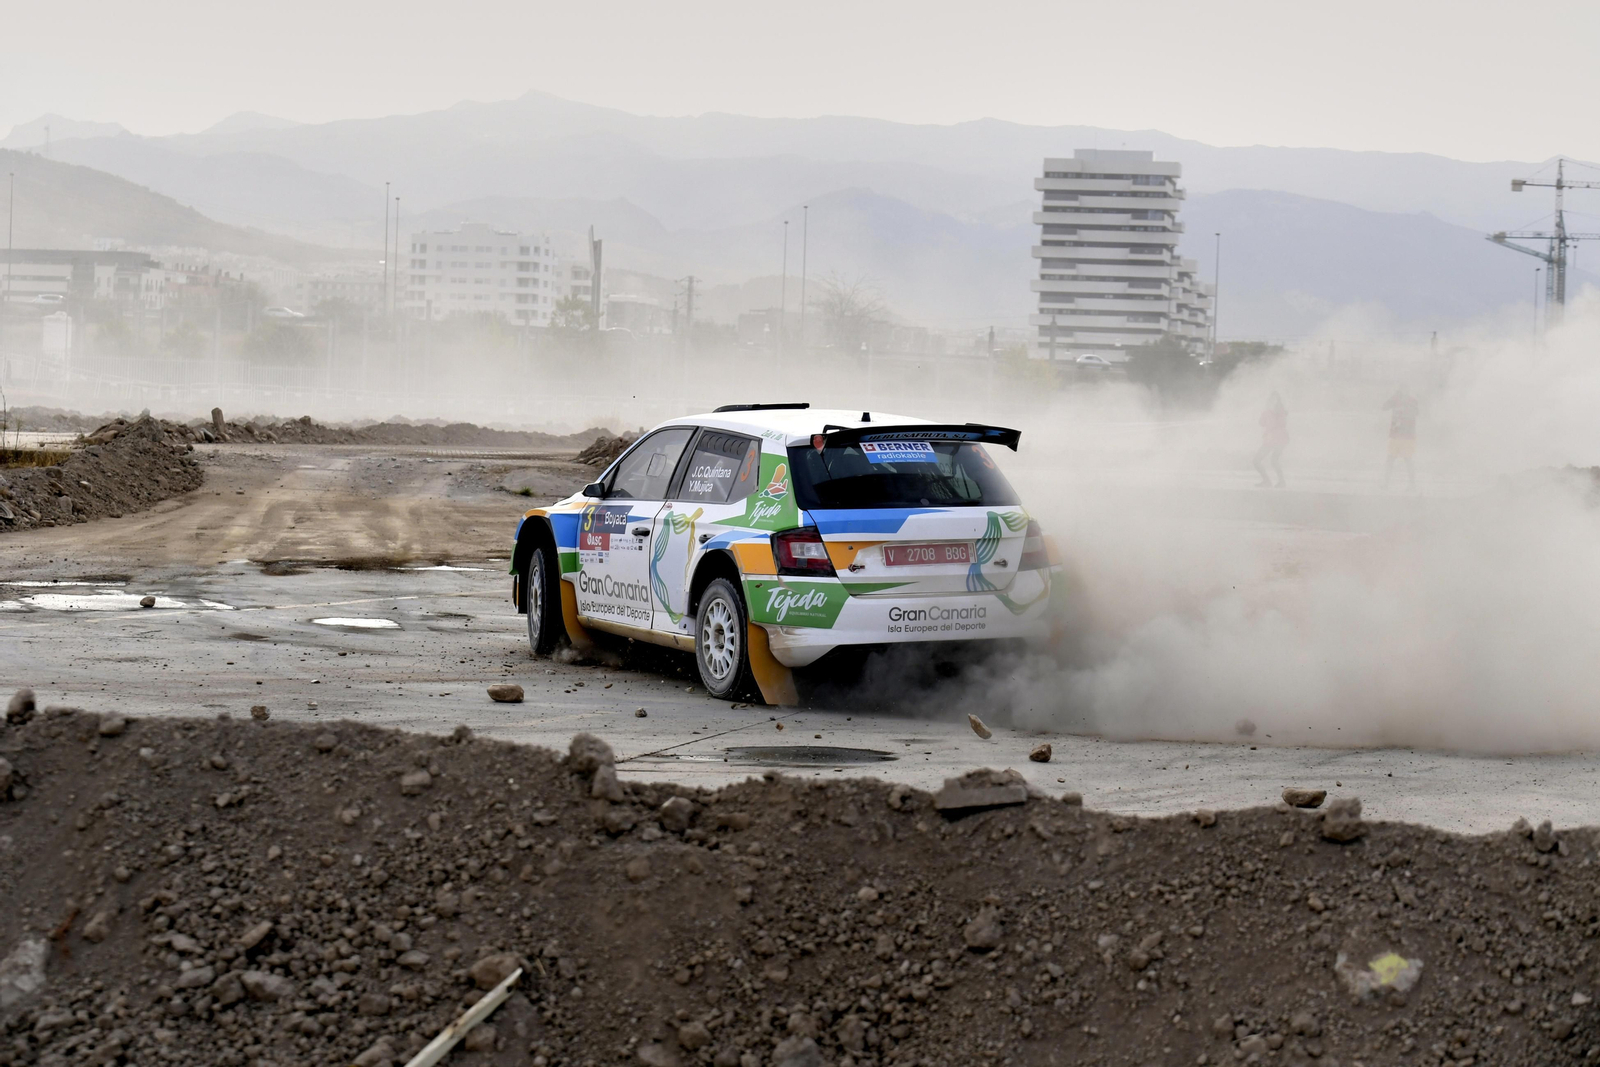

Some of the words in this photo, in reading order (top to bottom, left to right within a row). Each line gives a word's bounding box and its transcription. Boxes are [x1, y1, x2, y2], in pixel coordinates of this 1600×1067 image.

[878, 443, 931, 452] BERNER
[741, 449, 756, 482] 3
[584, 506, 596, 531] 3
[887, 549, 895, 562] V
[907, 547, 936, 562] 2708
[945, 546, 966, 560] BBG
[579, 570, 605, 596] Gran
[604, 574, 649, 603] Canaria
[590, 601, 616, 616] Europea
[616, 604, 626, 616] del
[626, 605, 651, 621] Deporte
[766, 586, 828, 622] Tejeda
[889, 606, 927, 621] Gran
[928, 604, 987, 621] Canaria
[887, 625, 902, 633] Isla
[904, 624, 938, 633] Europea
[940, 623, 953, 631] del
[954, 621, 987, 632] Deporte
